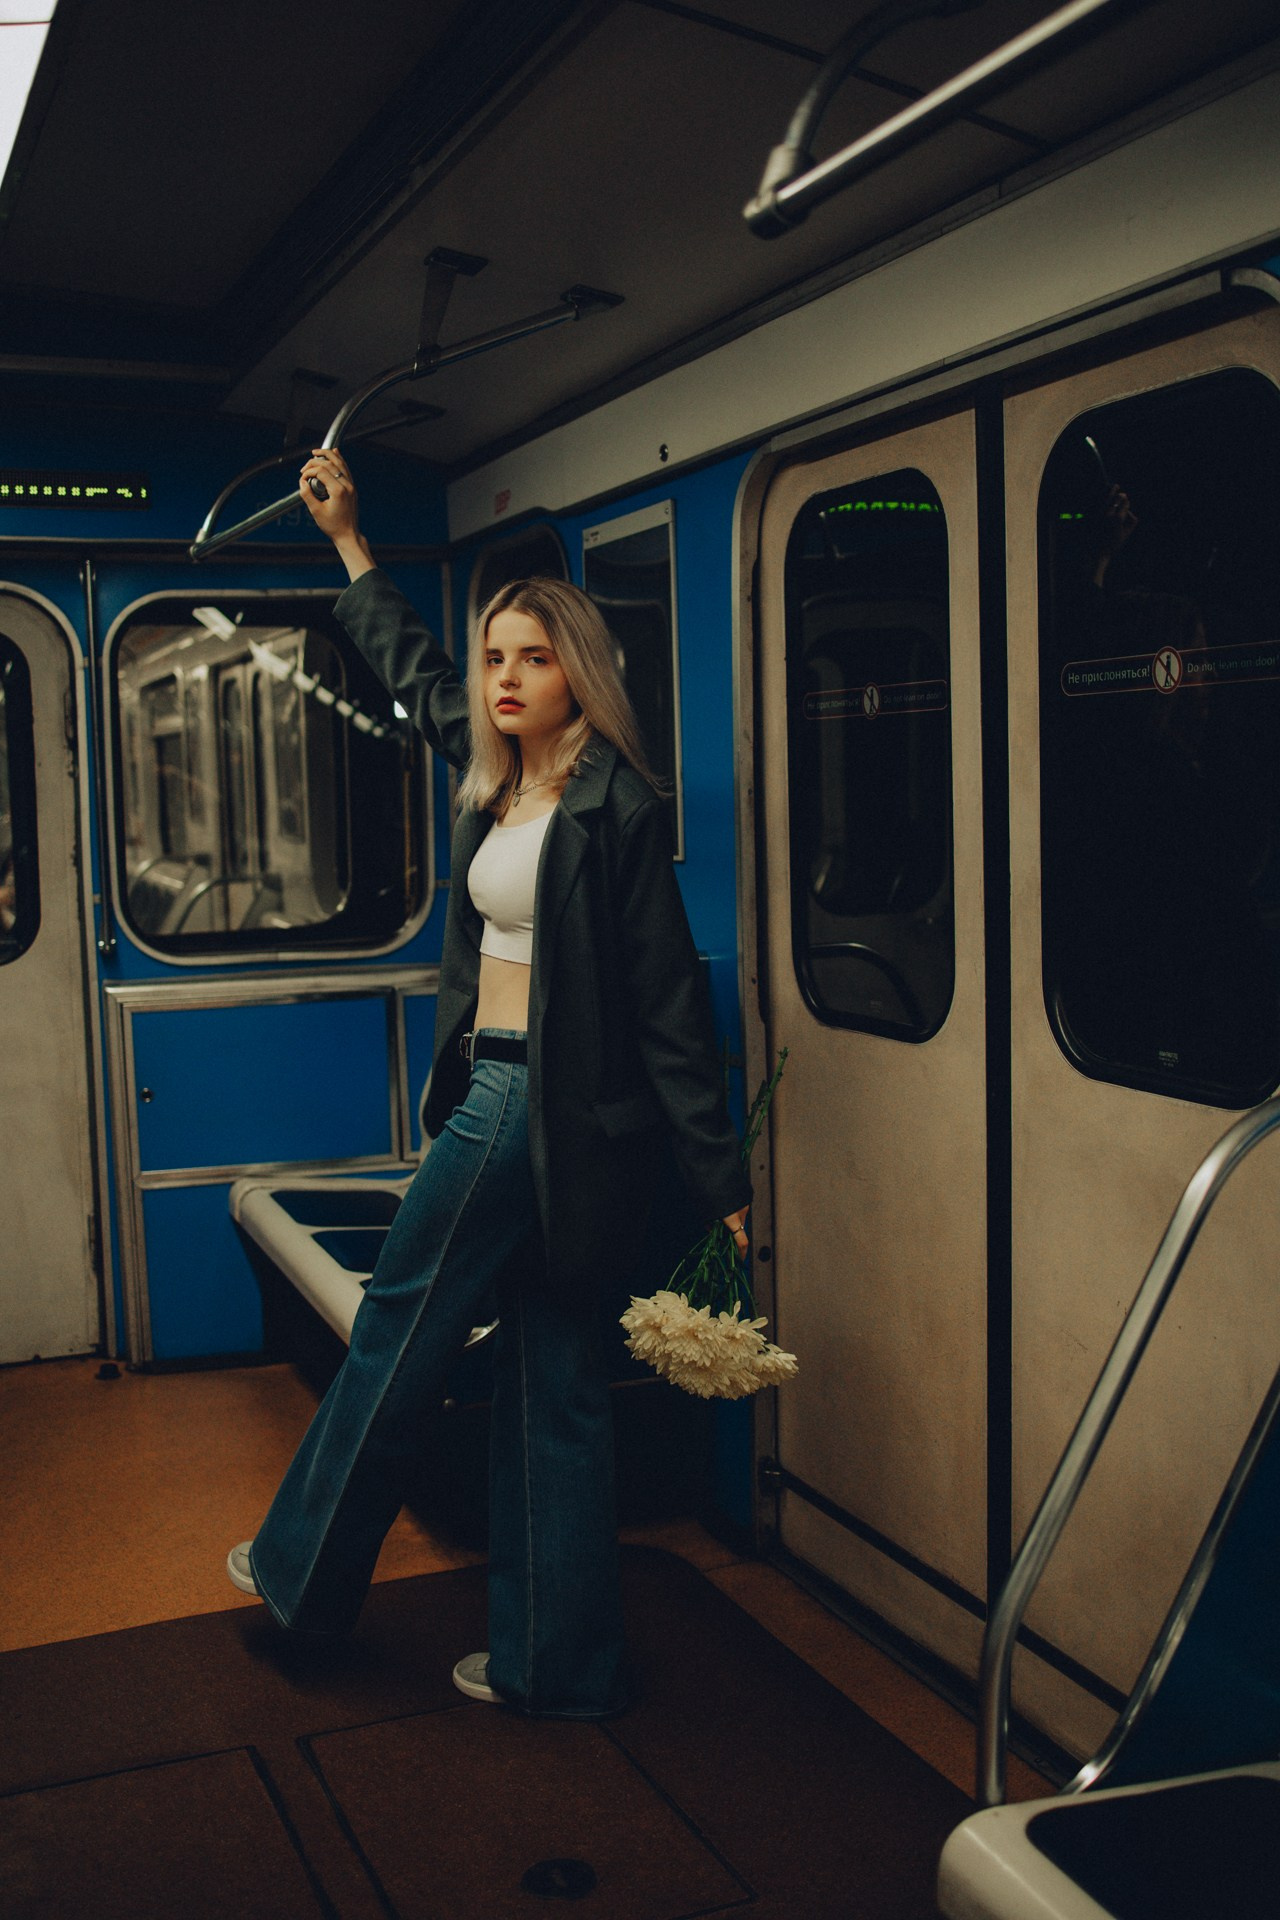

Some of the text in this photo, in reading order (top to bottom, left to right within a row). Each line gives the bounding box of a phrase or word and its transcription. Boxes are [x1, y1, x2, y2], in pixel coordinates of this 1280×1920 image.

[1068, 665, 1150, 686] Не прислоняться!
[1187, 662, 1200, 673] Do
